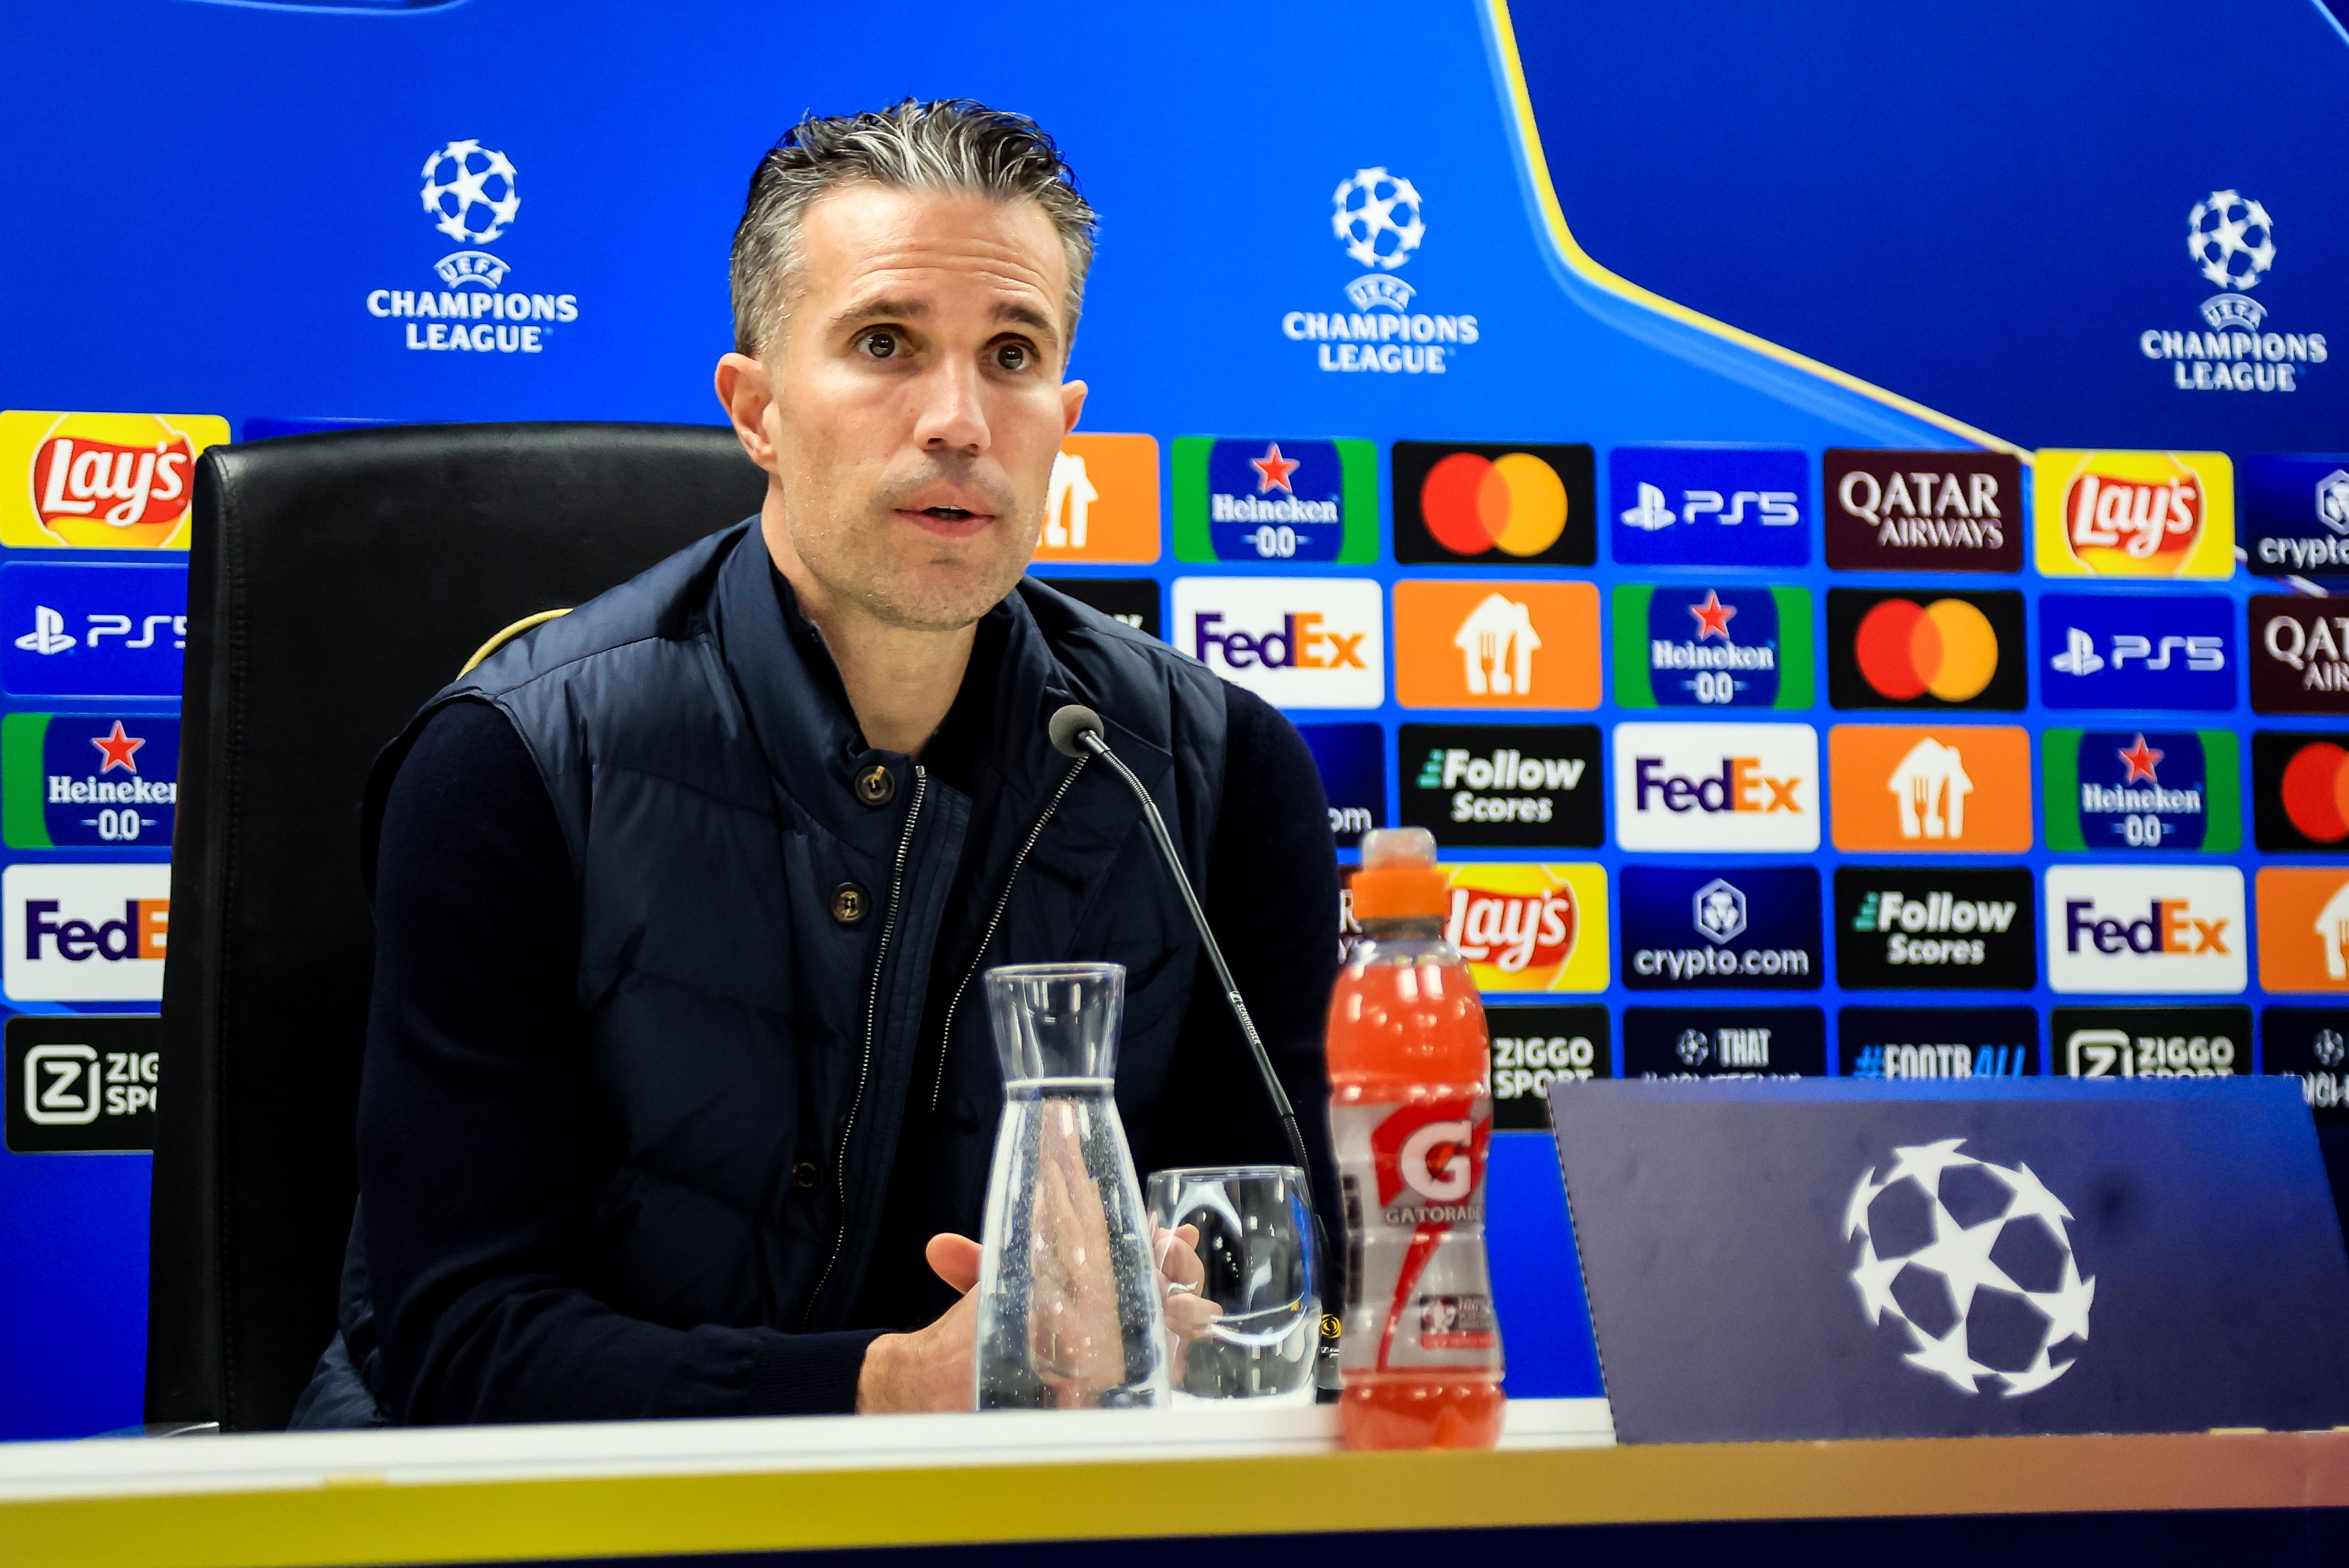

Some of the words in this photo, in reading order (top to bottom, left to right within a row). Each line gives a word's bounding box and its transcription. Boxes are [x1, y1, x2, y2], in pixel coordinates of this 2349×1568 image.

[440, 257, 504, 284] UEFA
[367, 289, 579, 322] CHAMPIONS
[406, 323, 543, 353] LEAGUE
[1282, 311, 1480, 344] CHAMPIONS
[1318, 344, 1446, 374] LEAGUE
[2140, 329, 2328, 363] CHAMPIONS
[2174, 361, 2296, 392] LEAGUE
[42, 438, 188, 527] Lay's
[1838, 471, 2002, 526] QATAR
[1212, 494, 1339, 523] Heineken
[1683, 490, 1799, 526] PS5
[2073, 474, 2197, 558] Lay's
[1878, 516, 2005, 549] AIRWAYS
[87, 613, 187, 649] PS
[1196, 612, 1368, 669] FedEx
[1652, 639, 1775, 670] Heineken
[2111, 635, 2225, 671] PS5
[1442, 748, 1585, 790] Follow
[1636, 757, 1804, 814] FedEx
[1451, 791, 1553, 823] Scores
[2082, 783, 2202, 814] Heineken
[1878, 891, 2017, 932] Follow
[2066, 898, 2232, 955] FedEx
[26, 898, 171, 961] FedE
[1446, 888, 1570, 971] Lay's
[1633, 945, 1810, 979] crypto.com
[1886, 933, 1986, 964] Scores
[1237, 1003, 1261, 1045] SENNHEISER
[1492, 1036, 1595, 1068] ZIGGO
[1717, 1028, 1772, 1067] THAT
[2136, 1036, 2235, 1067] ZIGGO
[1402, 1120, 1472, 1201] G
